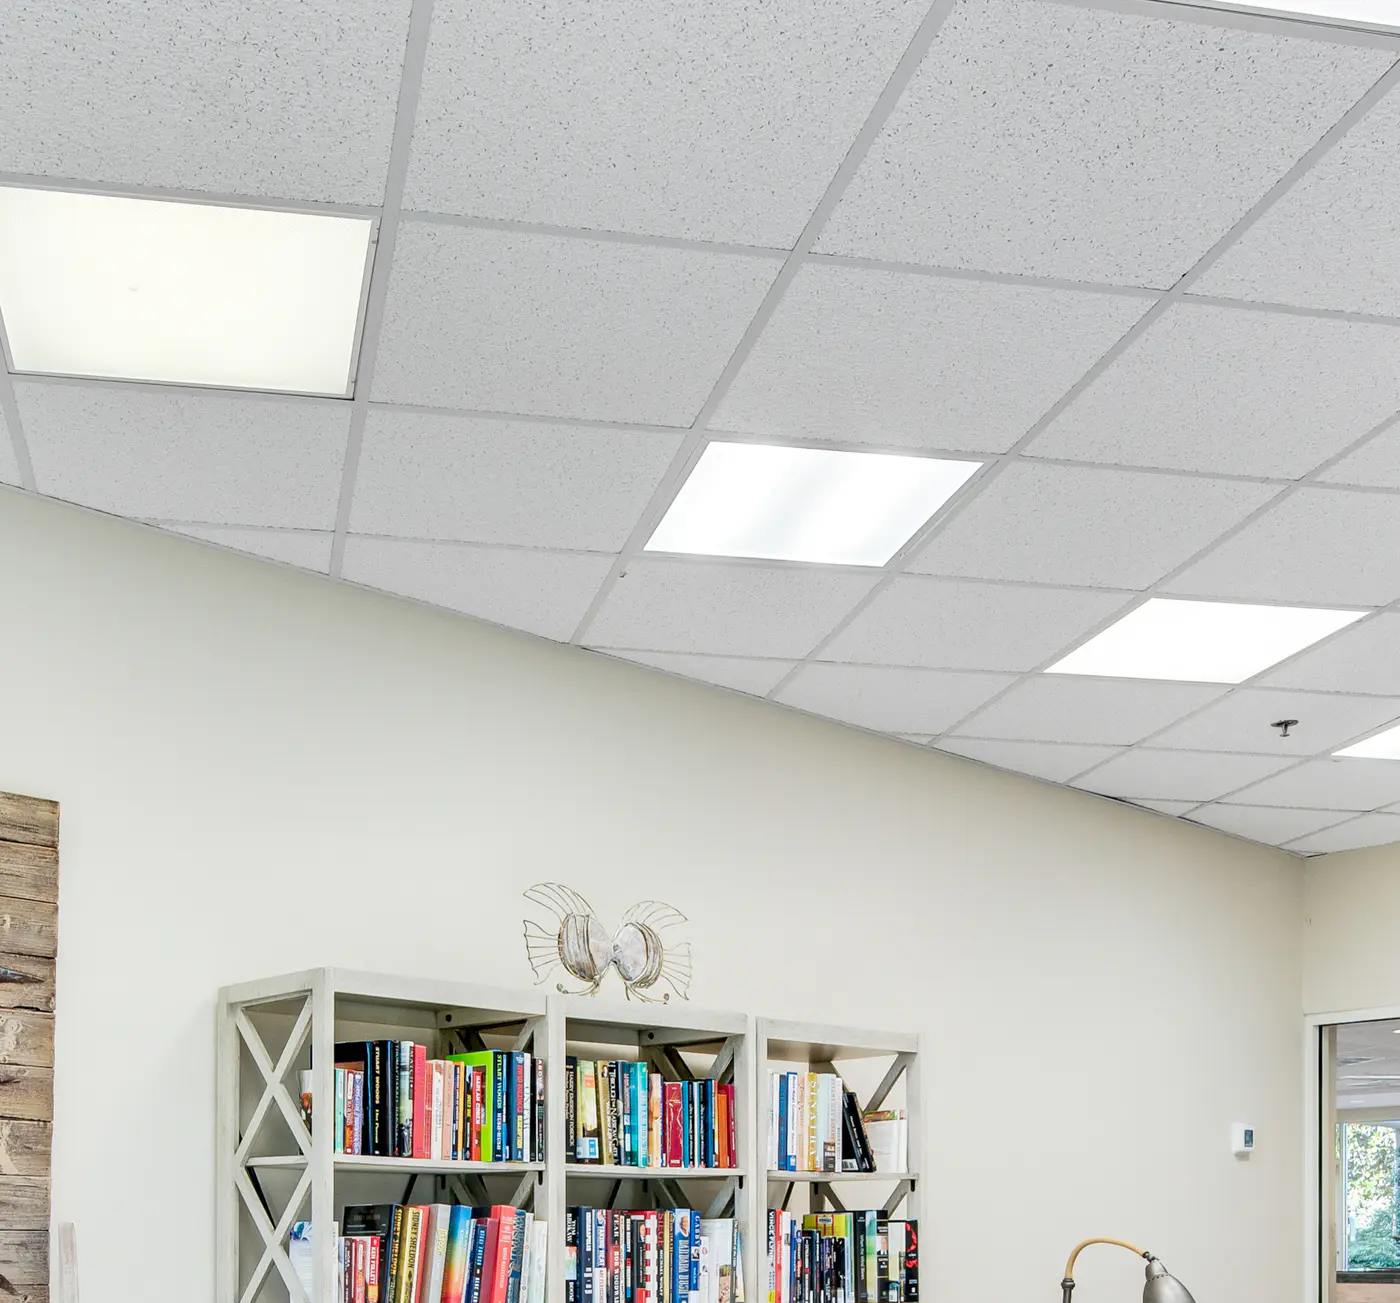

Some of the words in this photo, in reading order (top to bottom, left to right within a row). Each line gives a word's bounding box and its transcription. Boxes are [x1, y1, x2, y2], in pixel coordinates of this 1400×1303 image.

[393, 1208, 402, 1235] SIDNEY
[410, 1211, 420, 1235] SIDNEY
[597, 1226, 605, 1248] TAKING
[390, 1239, 400, 1275] SHELDON
[408, 1236, 417, 1269] SHELDON
[678, 1239, 689, 1273] BARBARA
[678, 1274, 689, 1294] BUSH
